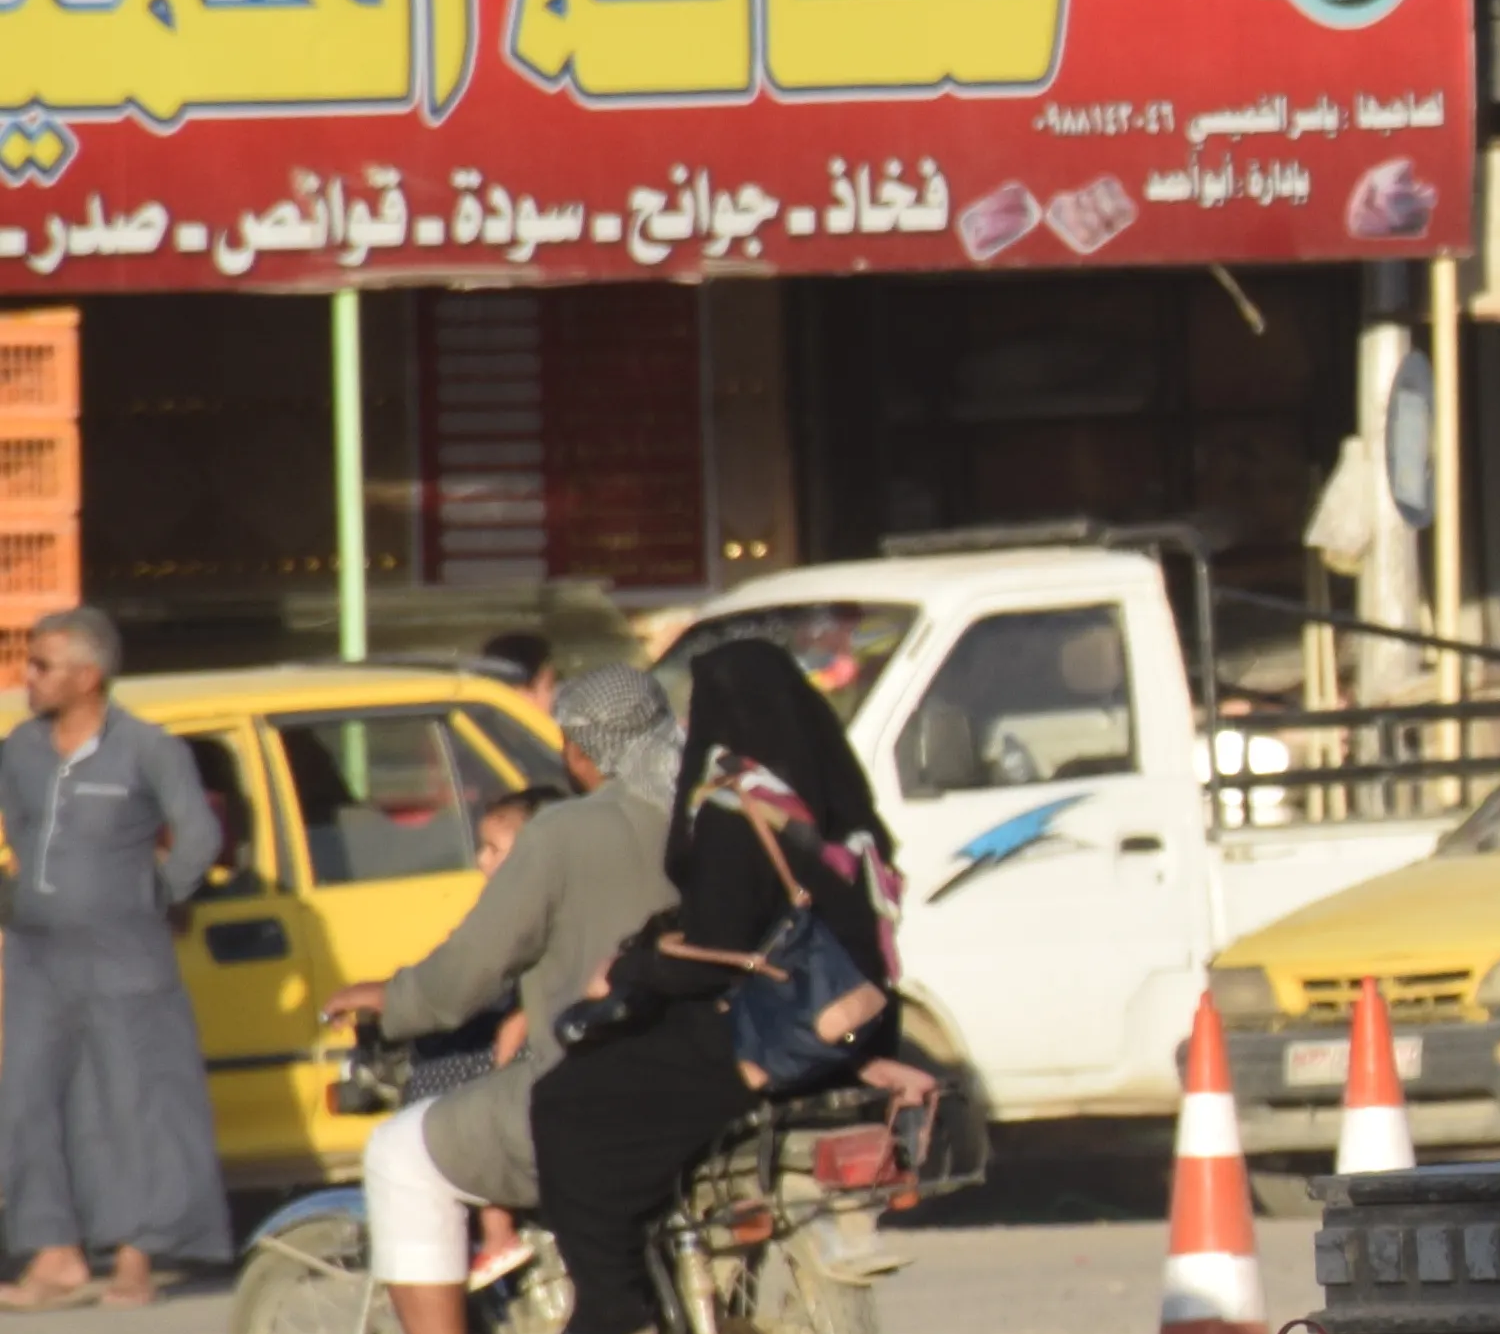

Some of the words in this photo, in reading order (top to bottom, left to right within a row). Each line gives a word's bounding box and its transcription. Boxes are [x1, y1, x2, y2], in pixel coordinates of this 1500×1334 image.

[26, 193, 170, 275] صدر
[212, 163, 410, 275] قوانص
[450, 169, 586, 259] سودة
[628, 161, 780, 265] جوانح
